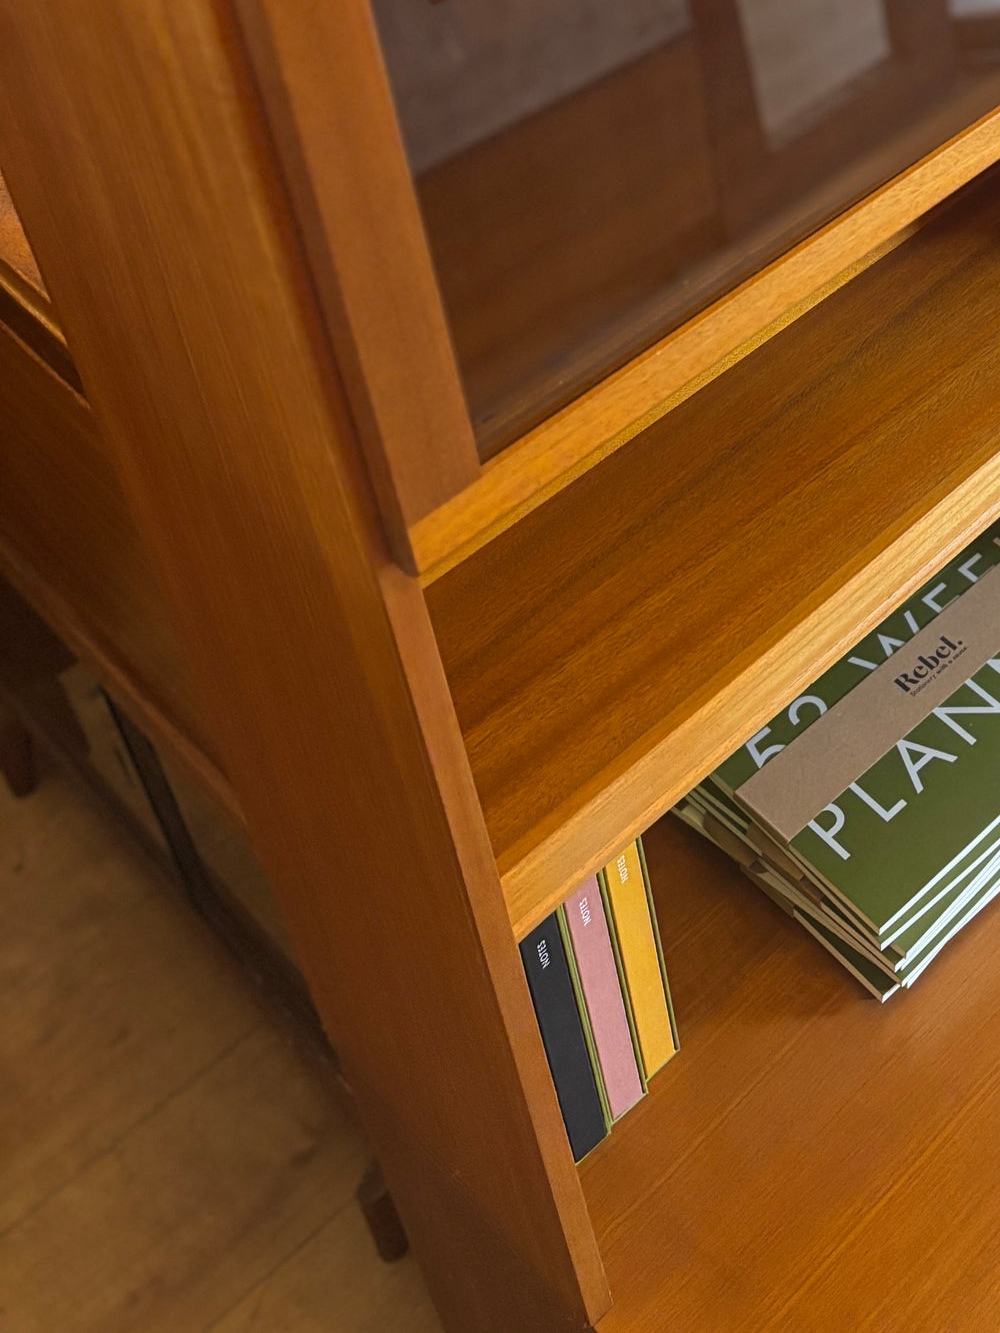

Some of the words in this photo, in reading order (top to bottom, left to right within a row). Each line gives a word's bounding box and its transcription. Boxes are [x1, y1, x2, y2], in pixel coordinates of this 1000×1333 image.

[894, 635, 963, 692] Rebel.
[617, 854, 629, 885] NOTES
[579, 897, 592, 927] NOTES
[537, 939, 551, 970] NOTES
